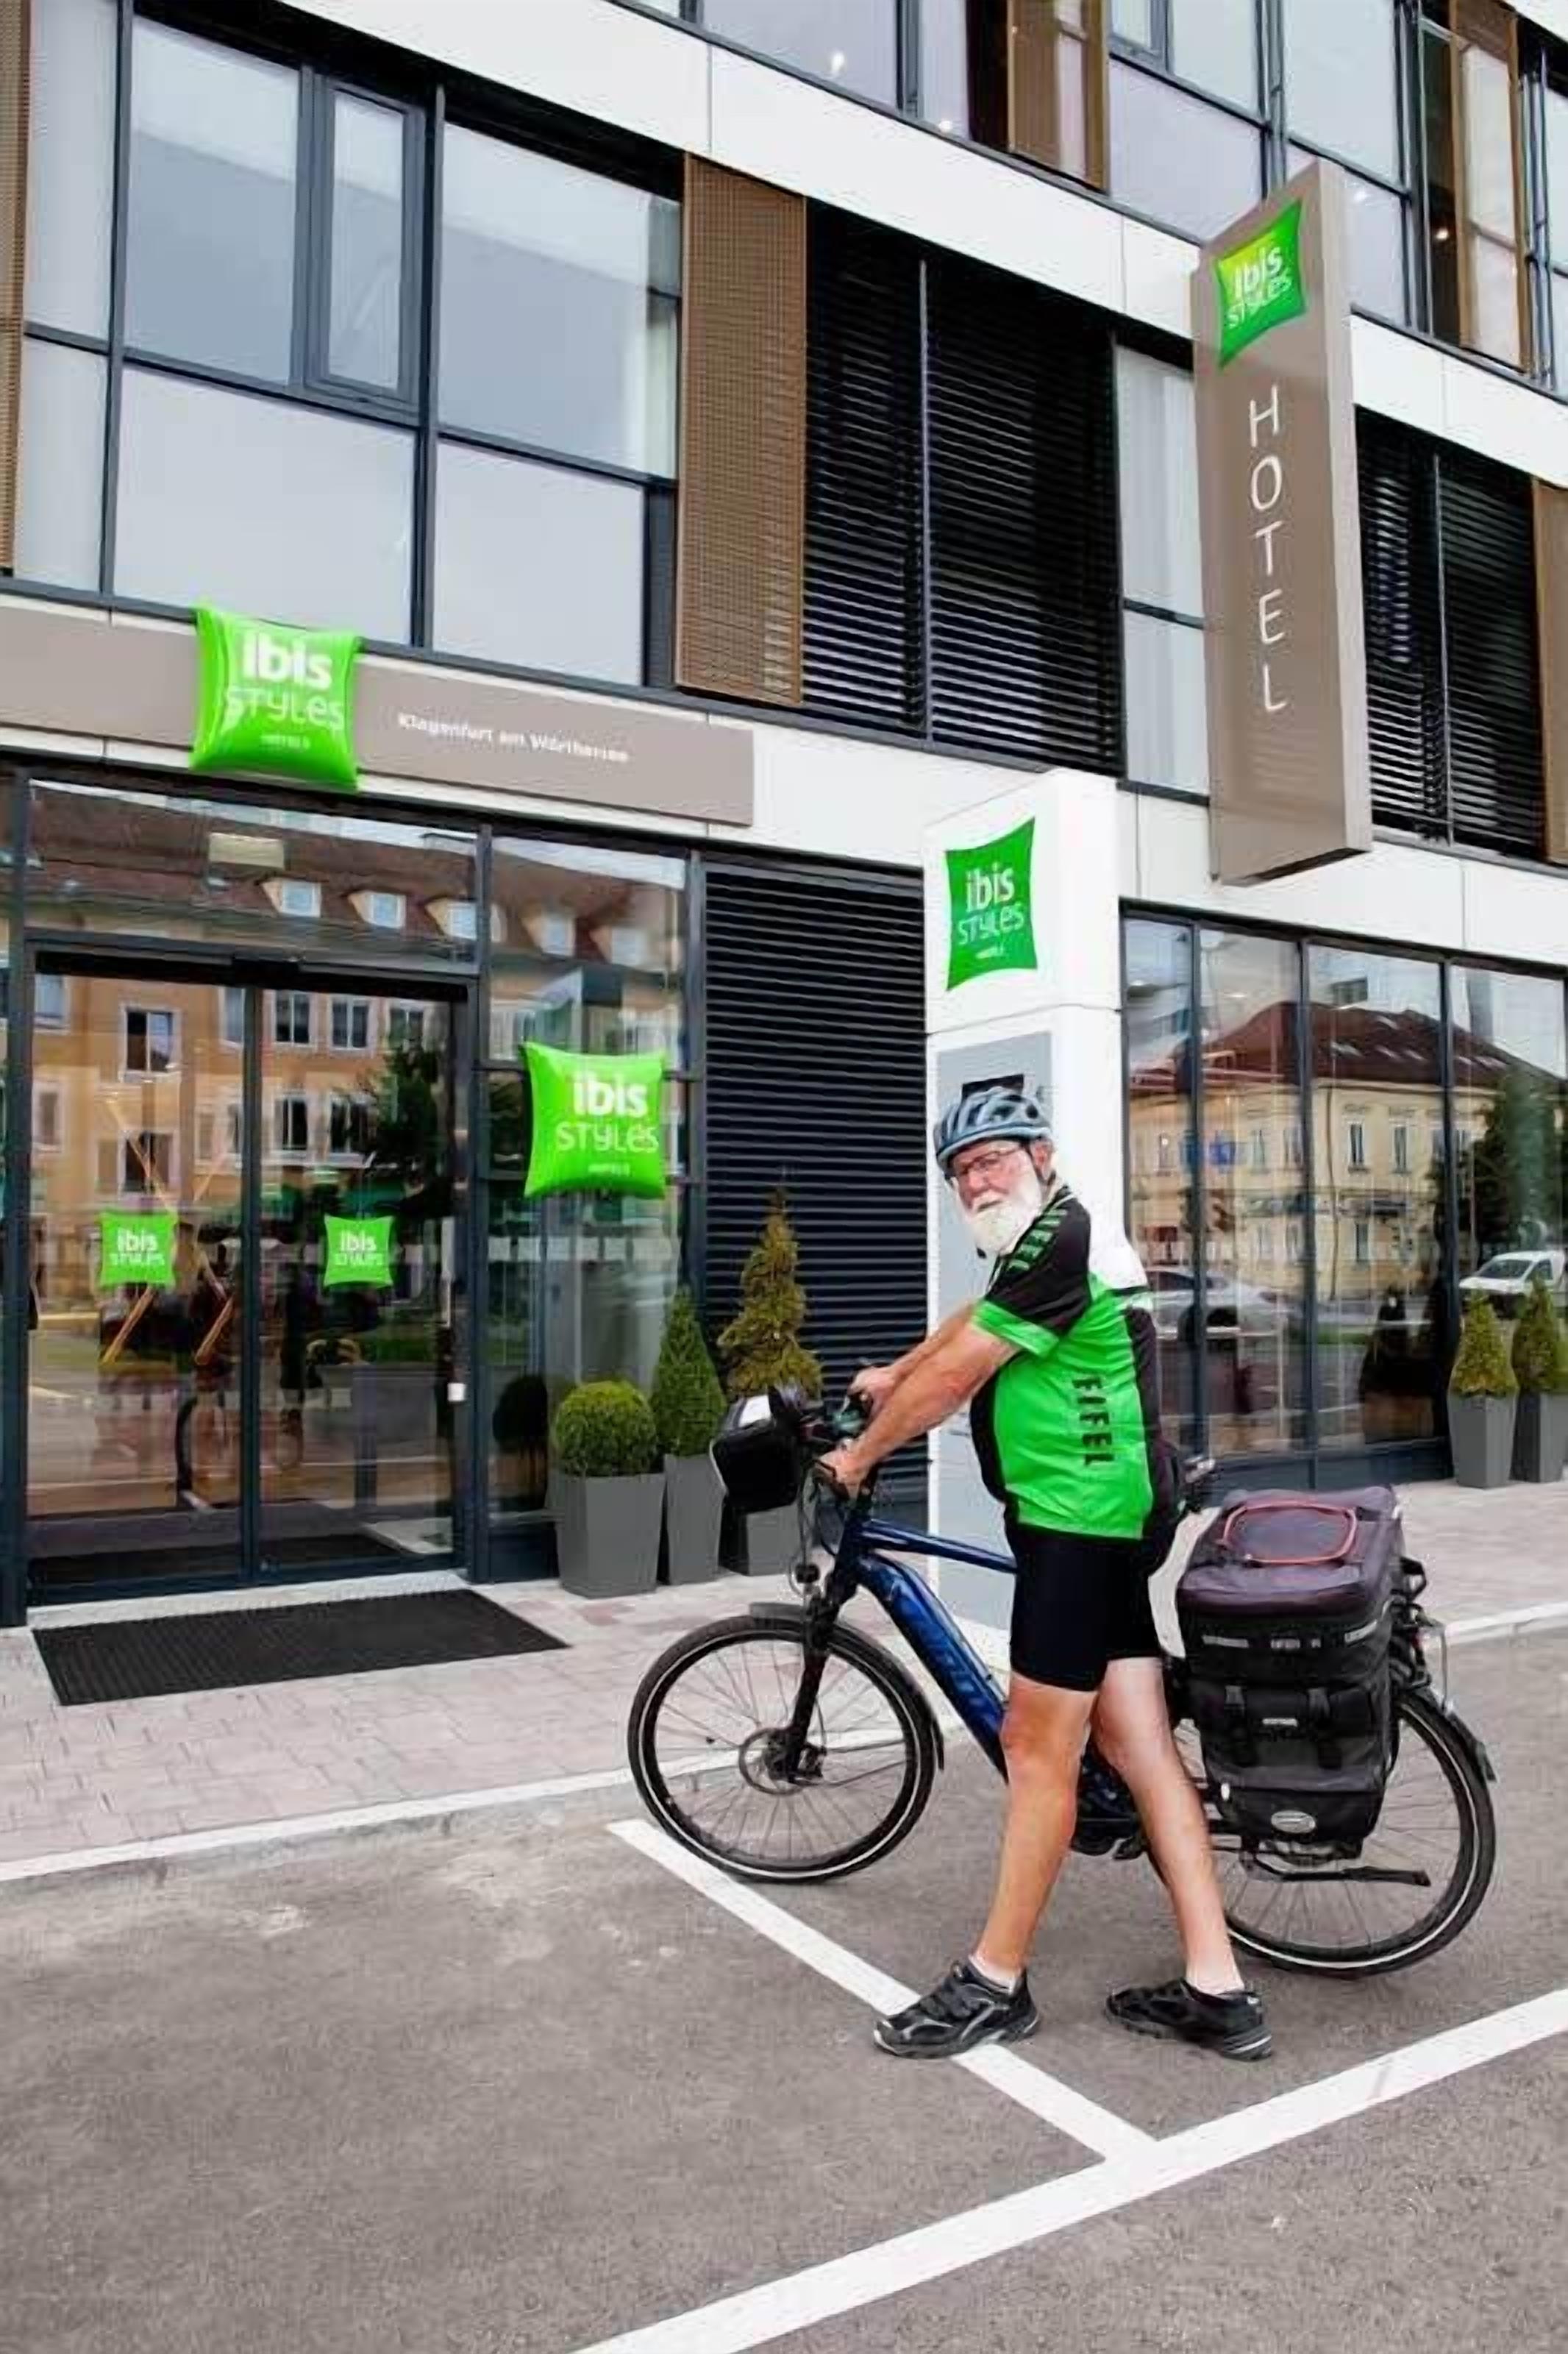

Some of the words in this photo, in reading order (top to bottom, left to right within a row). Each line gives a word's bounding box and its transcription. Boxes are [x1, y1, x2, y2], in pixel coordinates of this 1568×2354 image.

[1233, 247, 1283, 298] ibis
[1250, 383, 1288, 711] HOTEL
[241, 630, 332, 690] ibis
[966, 861, 1016, 913] ibis
[572, 1071, 648, 1118] ibis
